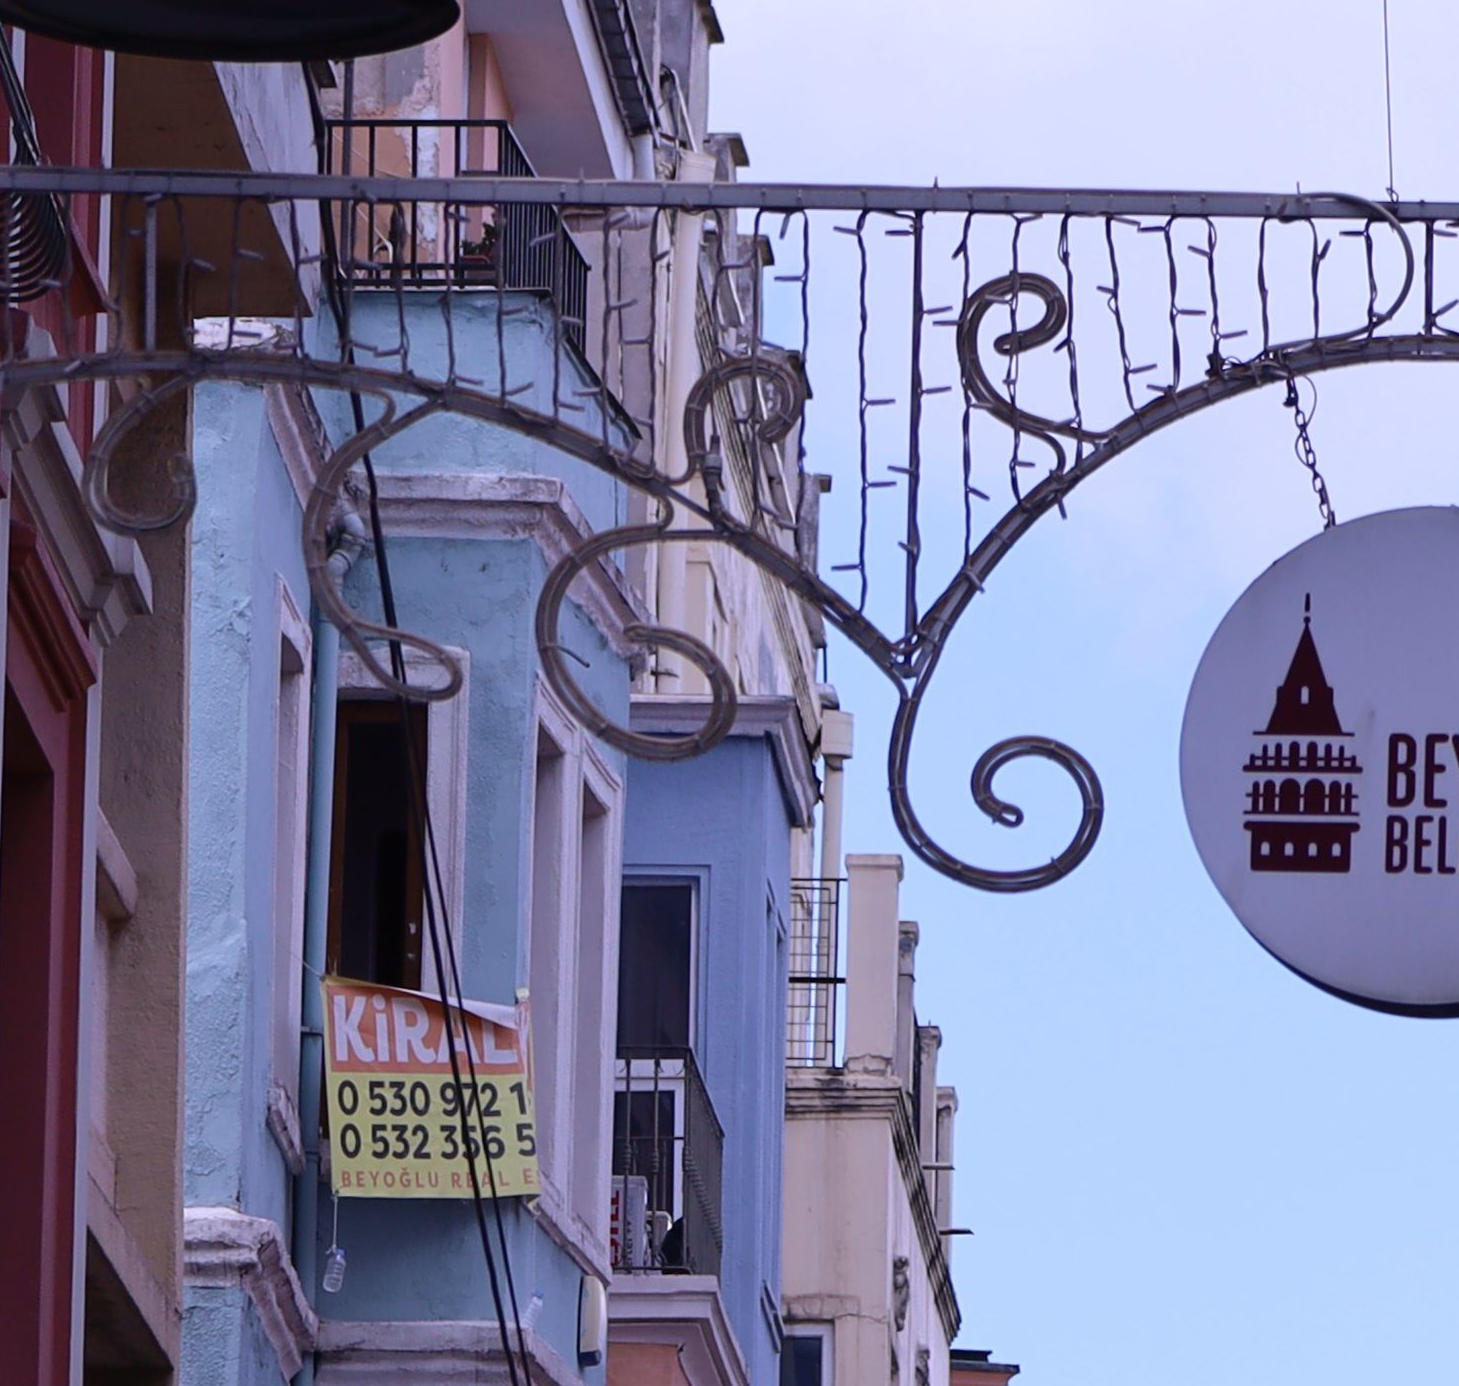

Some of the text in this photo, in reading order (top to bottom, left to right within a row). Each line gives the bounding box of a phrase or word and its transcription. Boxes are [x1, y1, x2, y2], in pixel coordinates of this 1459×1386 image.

[338, 1080, 528, 1117] 0 530 972 1
[340, 1123, 536, 1160] 0 532 356 5
[341, 1168, 439, 1188] BEYOĞLU
[452, 1170, 510, 1189] REAL
